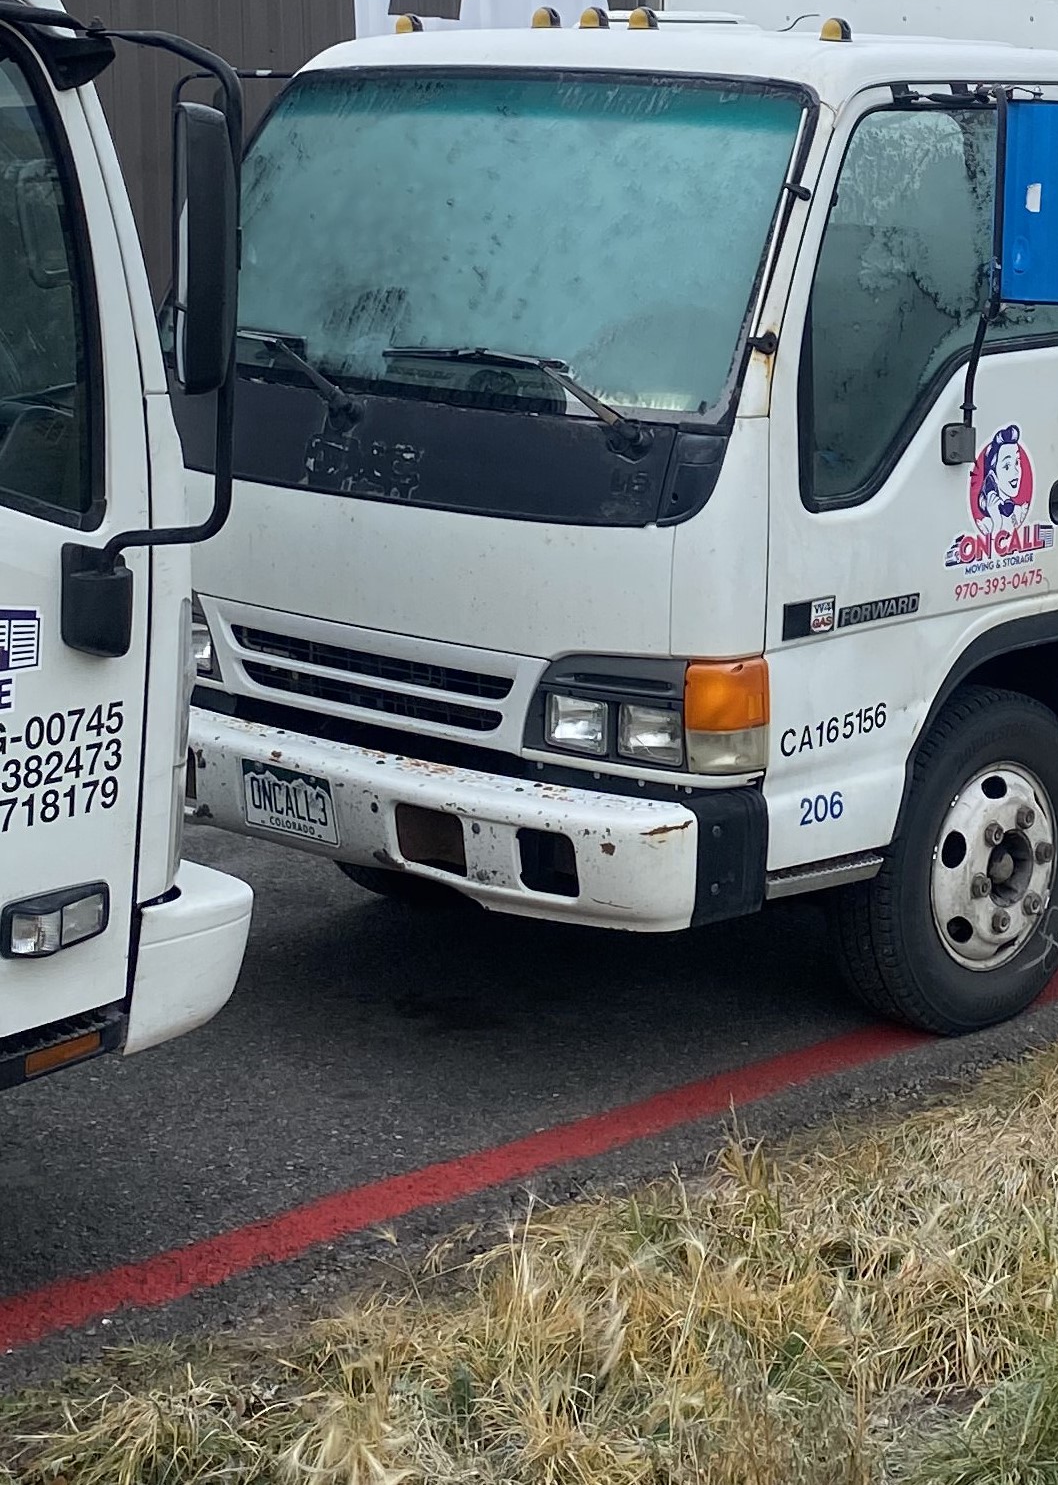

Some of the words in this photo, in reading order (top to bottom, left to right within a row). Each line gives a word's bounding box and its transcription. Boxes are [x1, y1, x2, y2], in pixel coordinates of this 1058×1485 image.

[960, 533, 992, 564] ON
[994, 524, 1046, 557] CALL
[964, 561, 994, 575] MOVING
[995, 559, 1001, 569] &
[1003, 553, 1033, 567] STORAGE
[954, 568, 1043, 602] 970-393-0475
[812, 615, 833, 629] GAS
[813, 601, 833, 614] W4
[840, 595, 919, 627] FORWARD
[780, 702, 887, 757] CA165156
[1, 738, 123, 793] 382473
[0, 775, 119, 833] 718179
[250, 776, 328, 827] ONCALL3
[800, 791, 844, 826] 206
[269, 815, 316, 835] COLORADO
